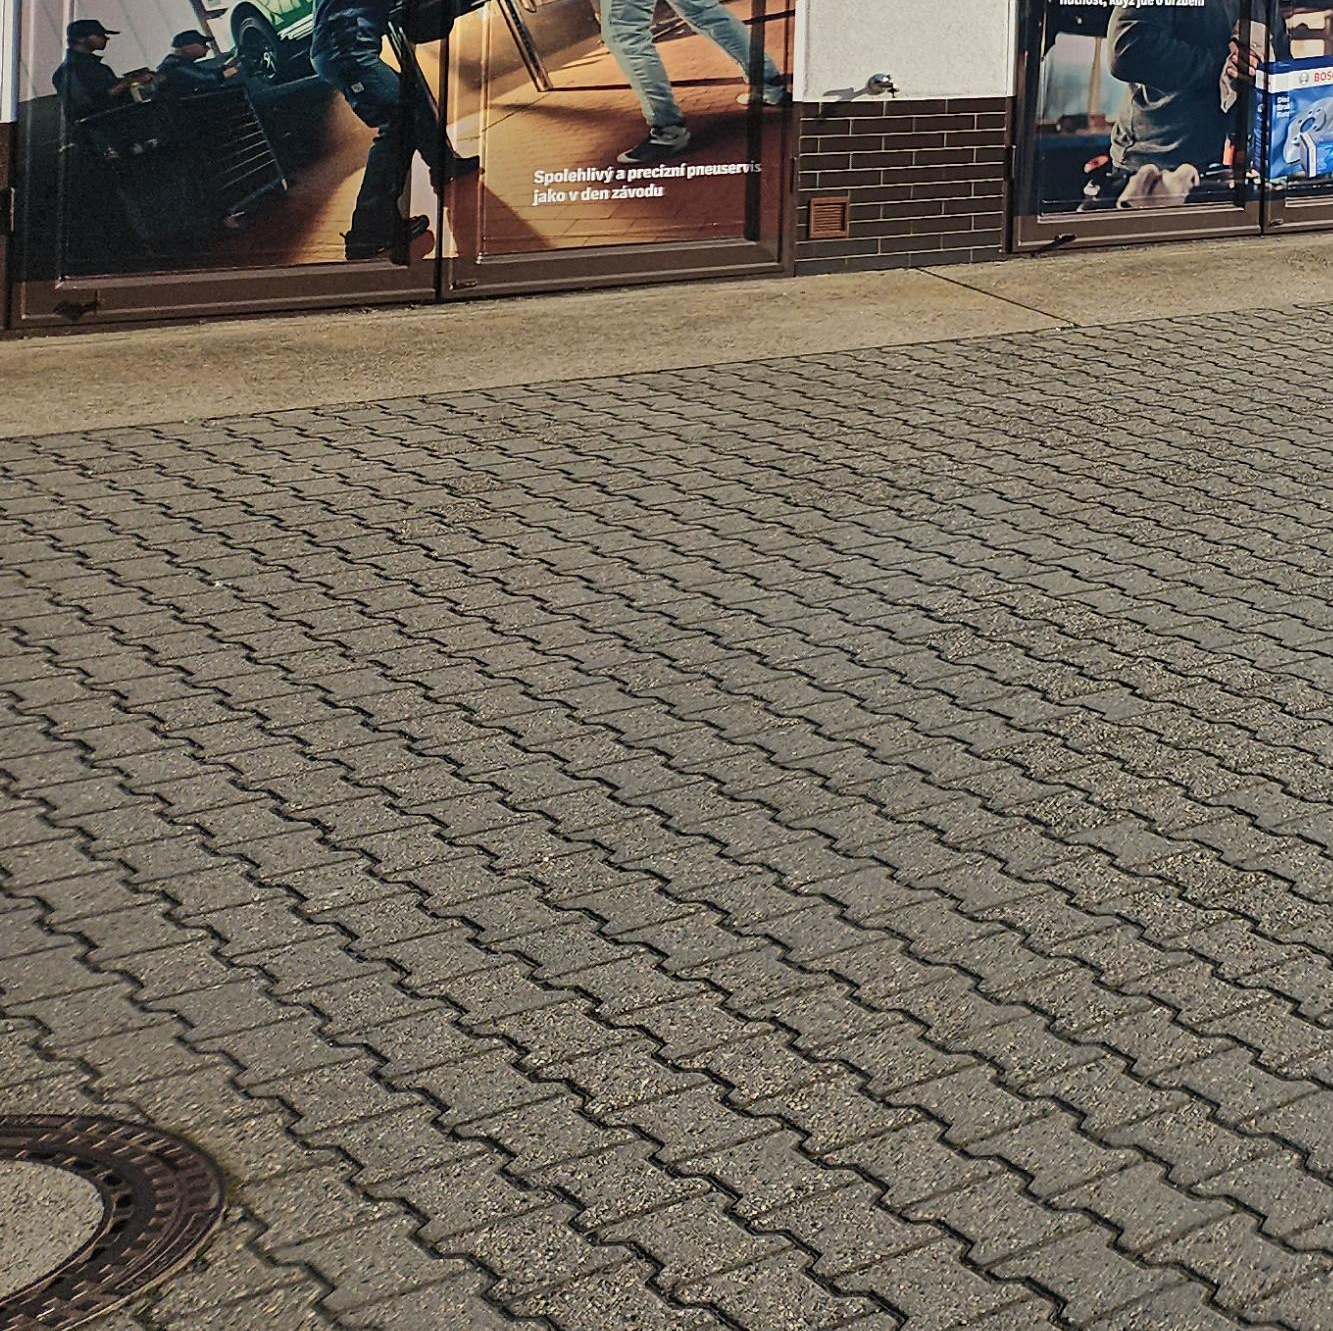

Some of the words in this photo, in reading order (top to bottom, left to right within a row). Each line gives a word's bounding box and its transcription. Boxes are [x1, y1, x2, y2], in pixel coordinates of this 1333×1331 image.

[533, 166, 614, 187] Spolehlivý
[616, 169, 625, 180] a
[627, 163, 685, 182] precizní
[687, 161, 762, 178] pneuservis
[532, 189, 566, 206] jako
[569, 191, 579, 201] v
[581, 186, 609, 201] den
[611, 184, 664, 200] závodu
